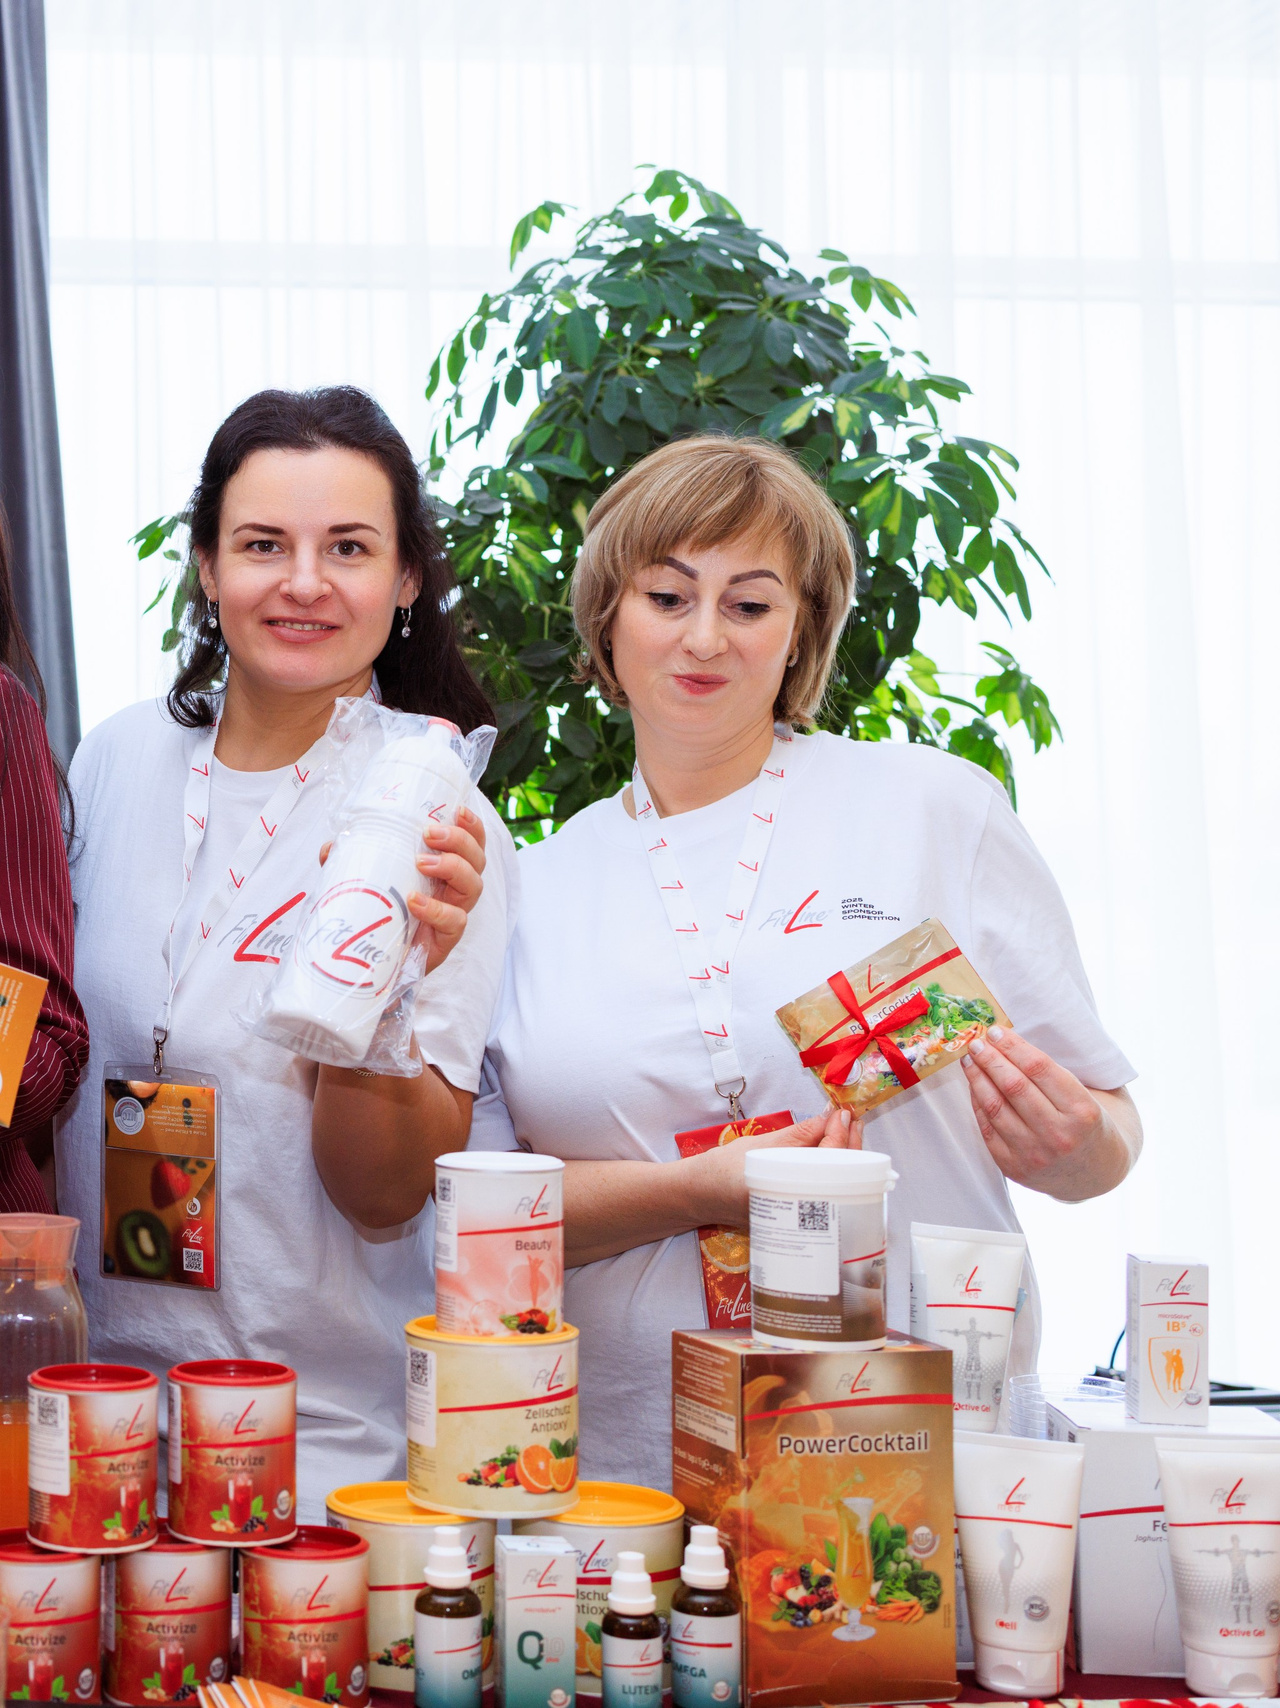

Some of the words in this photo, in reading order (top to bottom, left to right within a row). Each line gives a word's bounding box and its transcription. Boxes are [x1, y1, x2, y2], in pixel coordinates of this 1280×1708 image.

[758, 890, 828, 935] FitLine
[306, 915, 392, 970] FitLine
[515, 1240, 552, 1252] Beauty
[1156, 1270, 1194, 1297] FitLine
[715, 1283, 752, 1321] FitLine
[524, 1403, 571, 1420] Zellschutz
[953, 1402, 979, 1413] Active
[531, 1419, 568, 1434] Antioxy
[778, 1431, 929, 1454] PowerCocktail
[107, 1458, 150, 1475] Activize
[214, 1453, 266, 1467] Activize
[997, 1503, 1021, 1513] med
[1218, 1504, 1242, 1514] med
[145, 1620, 197, 1635] Activize
[1219, 1627, 1251, 1638] Active
[1253, 1628, 1265, 1637] Gel
[14, 1632, 67, 1647] Activize
[287, 1630, 340, 1644] Activize
[621, 1683, 659, 1695] LUTEIN
